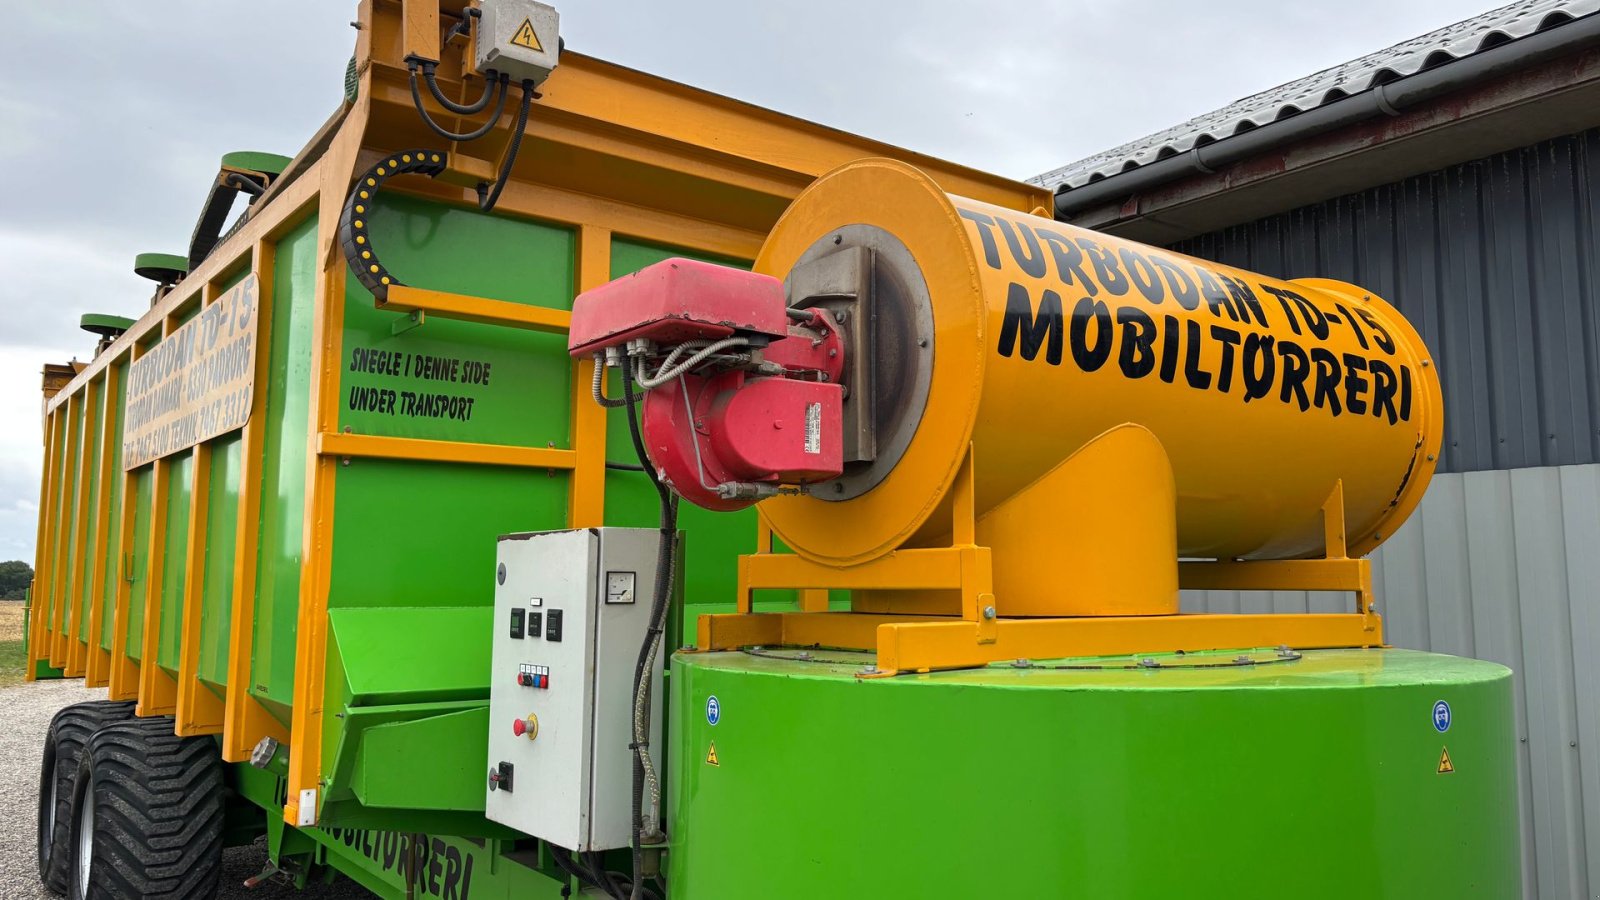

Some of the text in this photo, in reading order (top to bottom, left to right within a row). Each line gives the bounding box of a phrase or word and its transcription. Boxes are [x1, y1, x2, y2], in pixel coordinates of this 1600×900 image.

[959, 208, 1397, 356] TURBODAN TD-15
[129, 276, 254, 401] TURBODAN TD-15
[187, 358, 207, 403] 6330
[208, 332, 252, 393] PADBORG
[350, 347, 491, 386] SNEGLE I DENNE SIDE
[997, 282, 1412, 426] MOBILTØRRERI
[170, 410, 199, 450] TEKNIK
[199, 398, 222, 438] 7467
[223, 385, 249, 429] 3312
[349, 386, 475, 422] UNDER TRANSPORT
